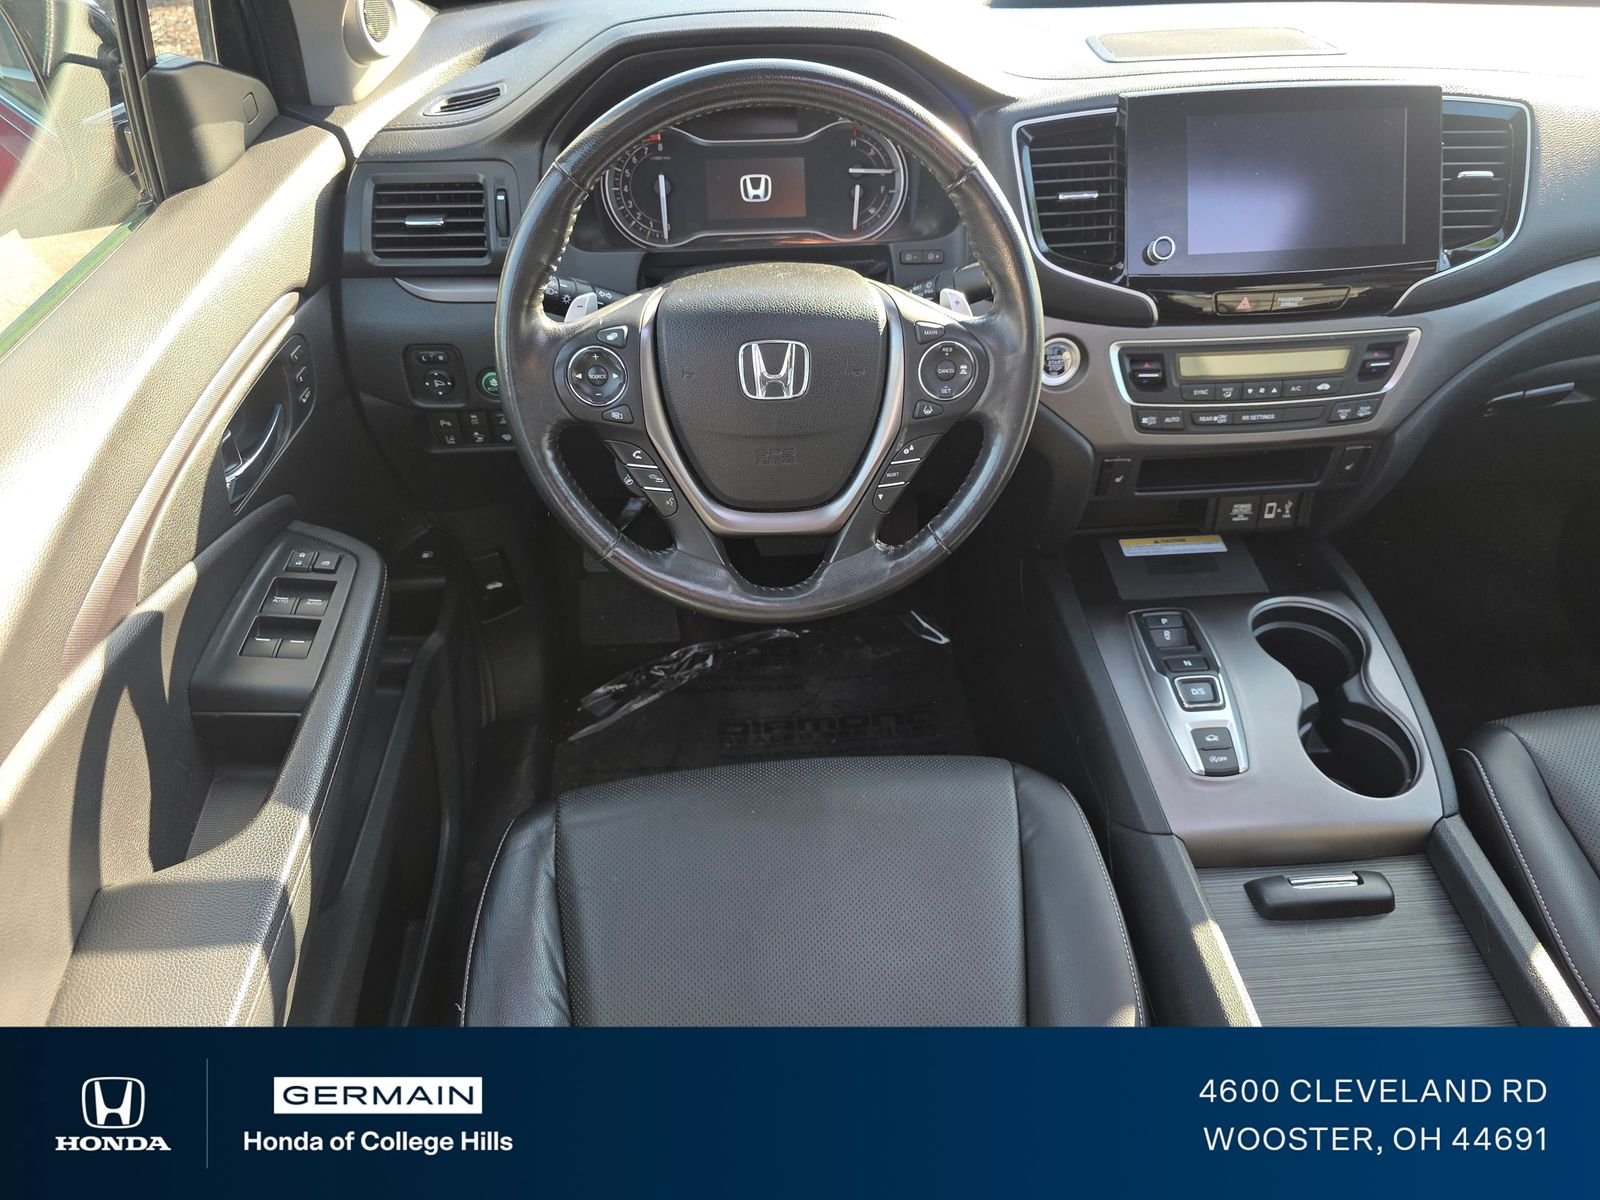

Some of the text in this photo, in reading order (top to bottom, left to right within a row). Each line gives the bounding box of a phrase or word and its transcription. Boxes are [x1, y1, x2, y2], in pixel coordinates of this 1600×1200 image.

[657, 143, 664, 151] 8
[625, 169, 630, 177] 5
[1190, 687, 1206, 696] D/S
